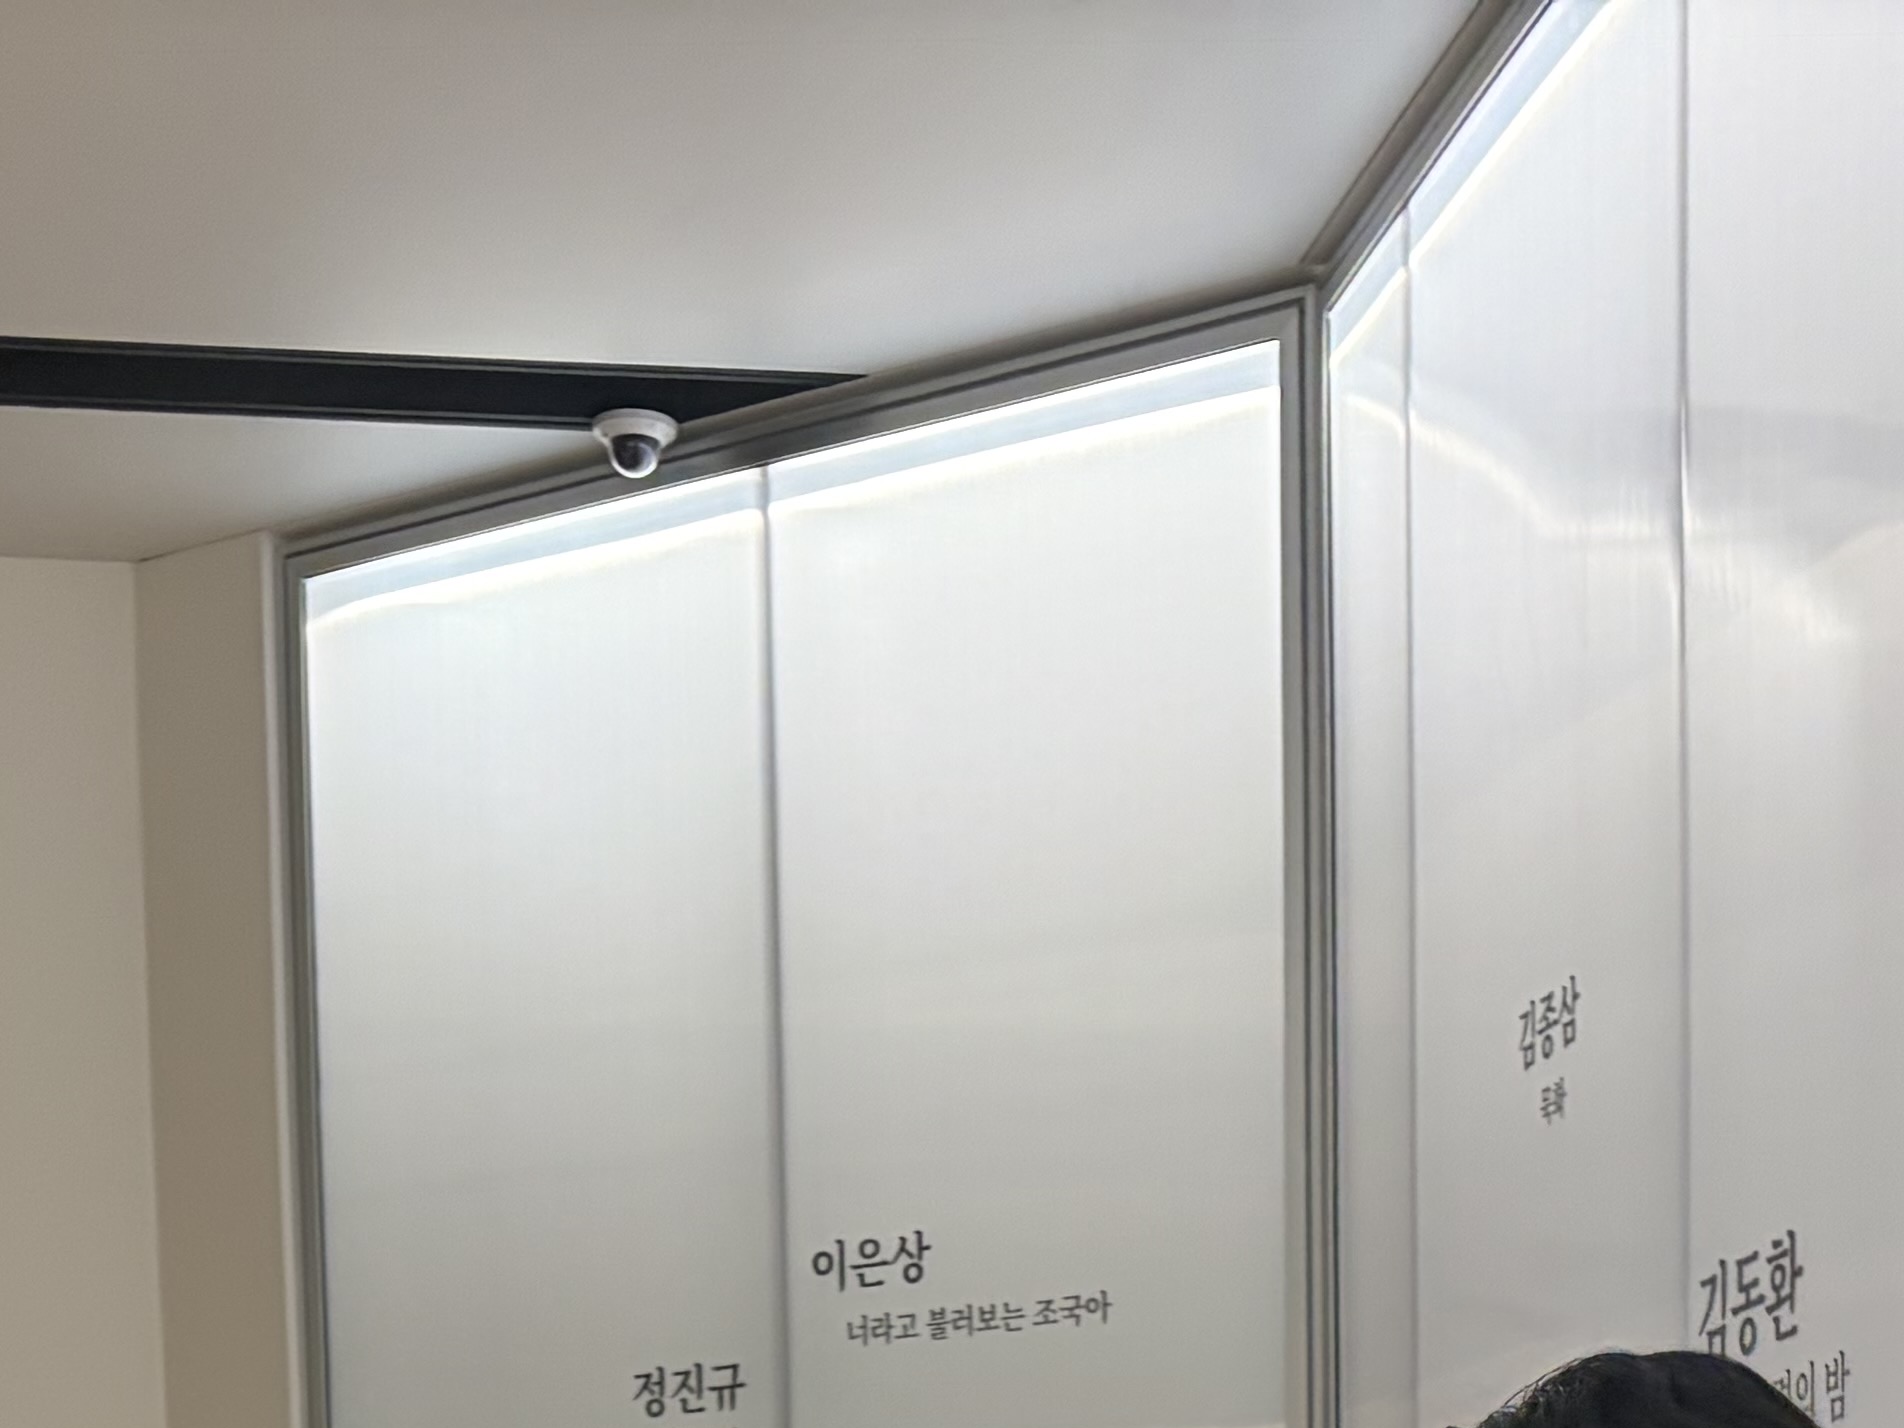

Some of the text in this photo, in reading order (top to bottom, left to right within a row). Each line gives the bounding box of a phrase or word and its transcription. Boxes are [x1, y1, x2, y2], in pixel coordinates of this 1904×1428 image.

[1518, 974, 1581, 1071] 김종삼
[811, 1229, 932, 1292] 이은상
[1698, 1229, 1805, 1358] 김동환
[846, 1289, 1113, 1346] 너라고 불러보는 조국아
[633, 1362, 747, 1418] 정진규
[1824, 1349, 1852, 1423] 밤
